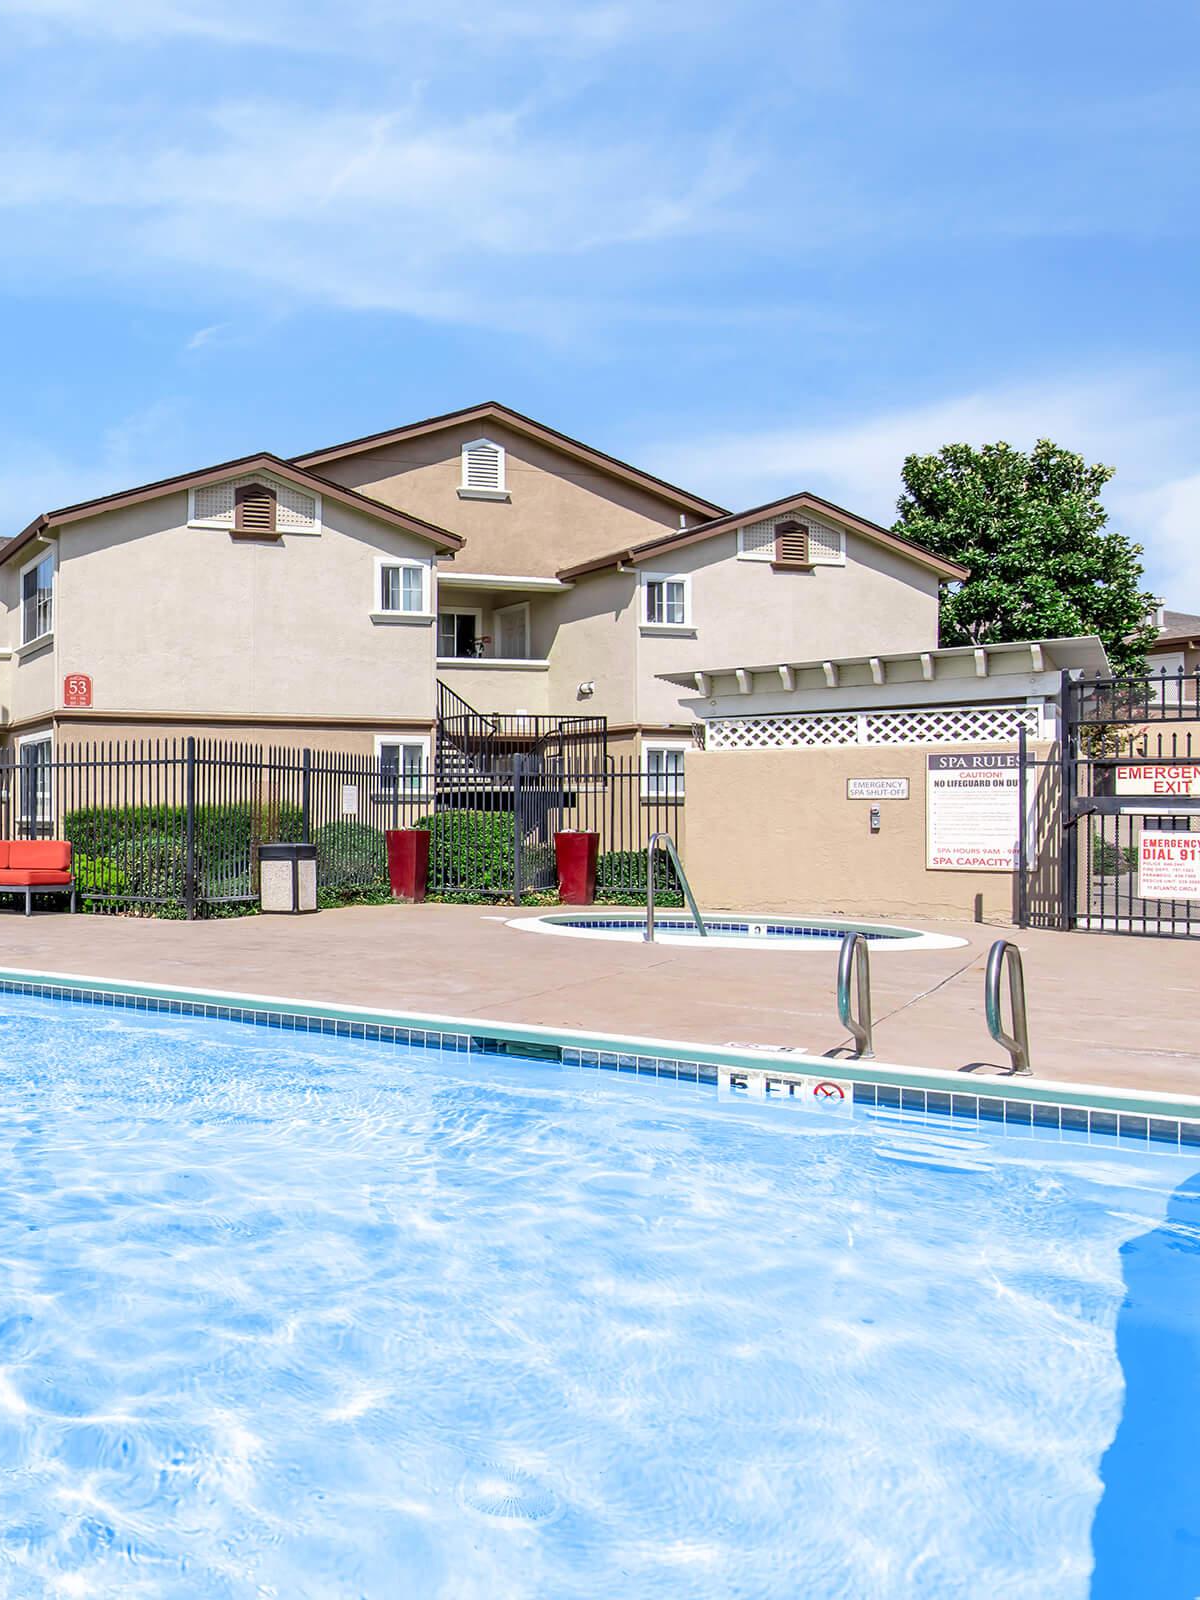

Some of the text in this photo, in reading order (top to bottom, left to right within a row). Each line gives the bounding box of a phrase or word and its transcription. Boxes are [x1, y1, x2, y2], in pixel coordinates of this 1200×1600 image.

[69, 680, 87, 695] 53
[939, 757, 968, 769] SPA
[959, 771, 1003, 779] CAUTION!
[853, 781, 903, 789] EMERGENCY
[934, 780, 946, 788] NO
[947, 780, 991, 788] LIFEGUARD
[993, 780, 1005, 788] ON
[1154, 781, 1193, 793] EXIT
[1143, 839, 1200, 848] EMERGENCY
[1143, 848, 1175, 860] DIAL
[932, 857, 953, 865] SPA
[956, 858, 1012, 867] CAPACITY
[730, 1073, 802, 1096] 5 FT
